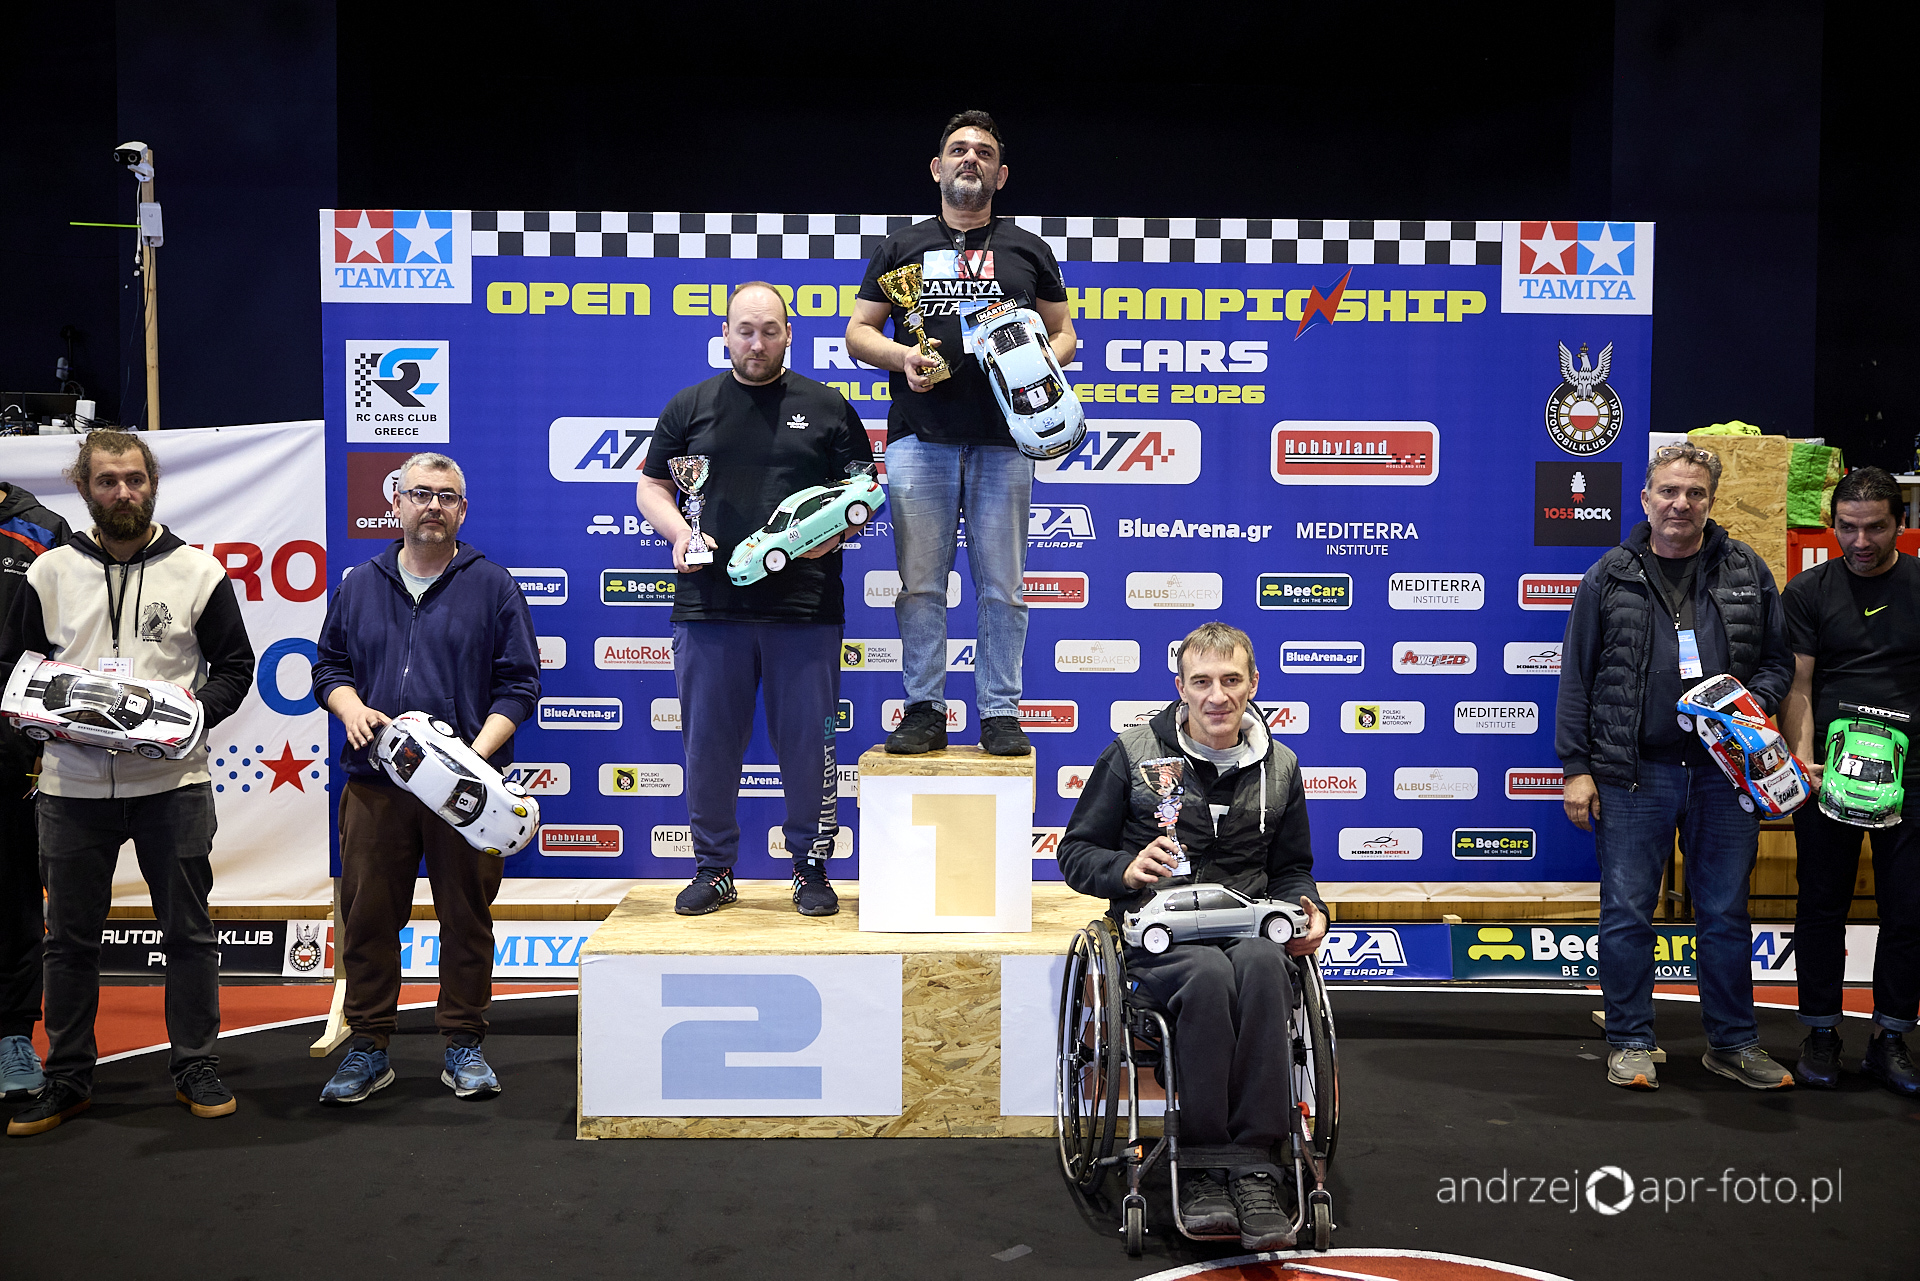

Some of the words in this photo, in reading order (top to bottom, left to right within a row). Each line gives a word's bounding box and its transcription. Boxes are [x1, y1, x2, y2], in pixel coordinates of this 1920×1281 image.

[335, 267, 454, 289] TAMIYA
[1519, 278, 1636, 301] TAMIYA
[486, 281, 651, 316] OPEN
[1066, 286, 1487, 323] HAMPIONSHIP
[978, 301, 1014, 320] MARTINI
[1105, 338, 1269, 373] CARS
[1034, 390, 1040, 399] 1
[1072, 384, 1159, 404] EECE
[1170, 384, 1266, 405] 2026
[356, 413, 371, 422] RC
[374, 413, 404, 422] CARS
[407, 413, 437, 422] CLUB
[1548, 397, 1608, 452] AUTOMOBILKLUB
[1606, 397, 1620, 438] POLSKI
[374, 427, 419, 436] GREECE
[574, 430, 656, 470] AT
[1056, 431, 1162, 471] ATA
[1285, 439, 1388, 456] Hobbyland
[1543, 507, 1612, 521] 1055ROCK
[356, 517, 404, 528] ΘΕΡΜ
[789, 530, 798, 540] 40
[1118, 517, 1272, 543] BlueArena.gr
[1296, 522, 1419, 540] MEDITERRA
[1036, 541, 1084, 549] EUROPE
[1326, 545, 1389, 556] INSTITUTE
[628, 580, 675, 593] BeeCa
[1022, 582, 1059, 592] byland
[1283, 584, 1345, 597] BeeCars
[1391, 579, 1482, 592] MEDITERRA
[1526, 584, 1577, 594] Hobbylan
[1413, 595, 1459, 604] INSTITUTE
[604, 646, 670, 660] AutoRok
[1286, 651, 1358, 664] BlueArena.gr
[128, 699, 138, 707] 5
[544, 707, 616, 721] BlueArena.gr
[1018, 709, 1052, 719] byland
[1262, 708, 1290, 728] TA
[1457, 707, 1536, 718] MEDITERRA
[1475, 721, 1516, 729] INSTITUTE
[1767, 752, 1773, 761] 4
[1304, 776, 1357, 790] utoRok
[1512, 777, 1563, 786] Hobbyland
[458, 797, 469, 806] 8
[545, 833, 597, 843] Hobbyland
[654, 831, 693, 842] MEDIT
[1475, 837, 1529, 849] BeeCars
[912, 793, 997, 917] 1
[1750, 931, 1797, 970] AT
[1343, 968, 1394, 976] EUROPE
[1561, 965, 1579, 977] BE
[661, 973, 822, 1100] 2
